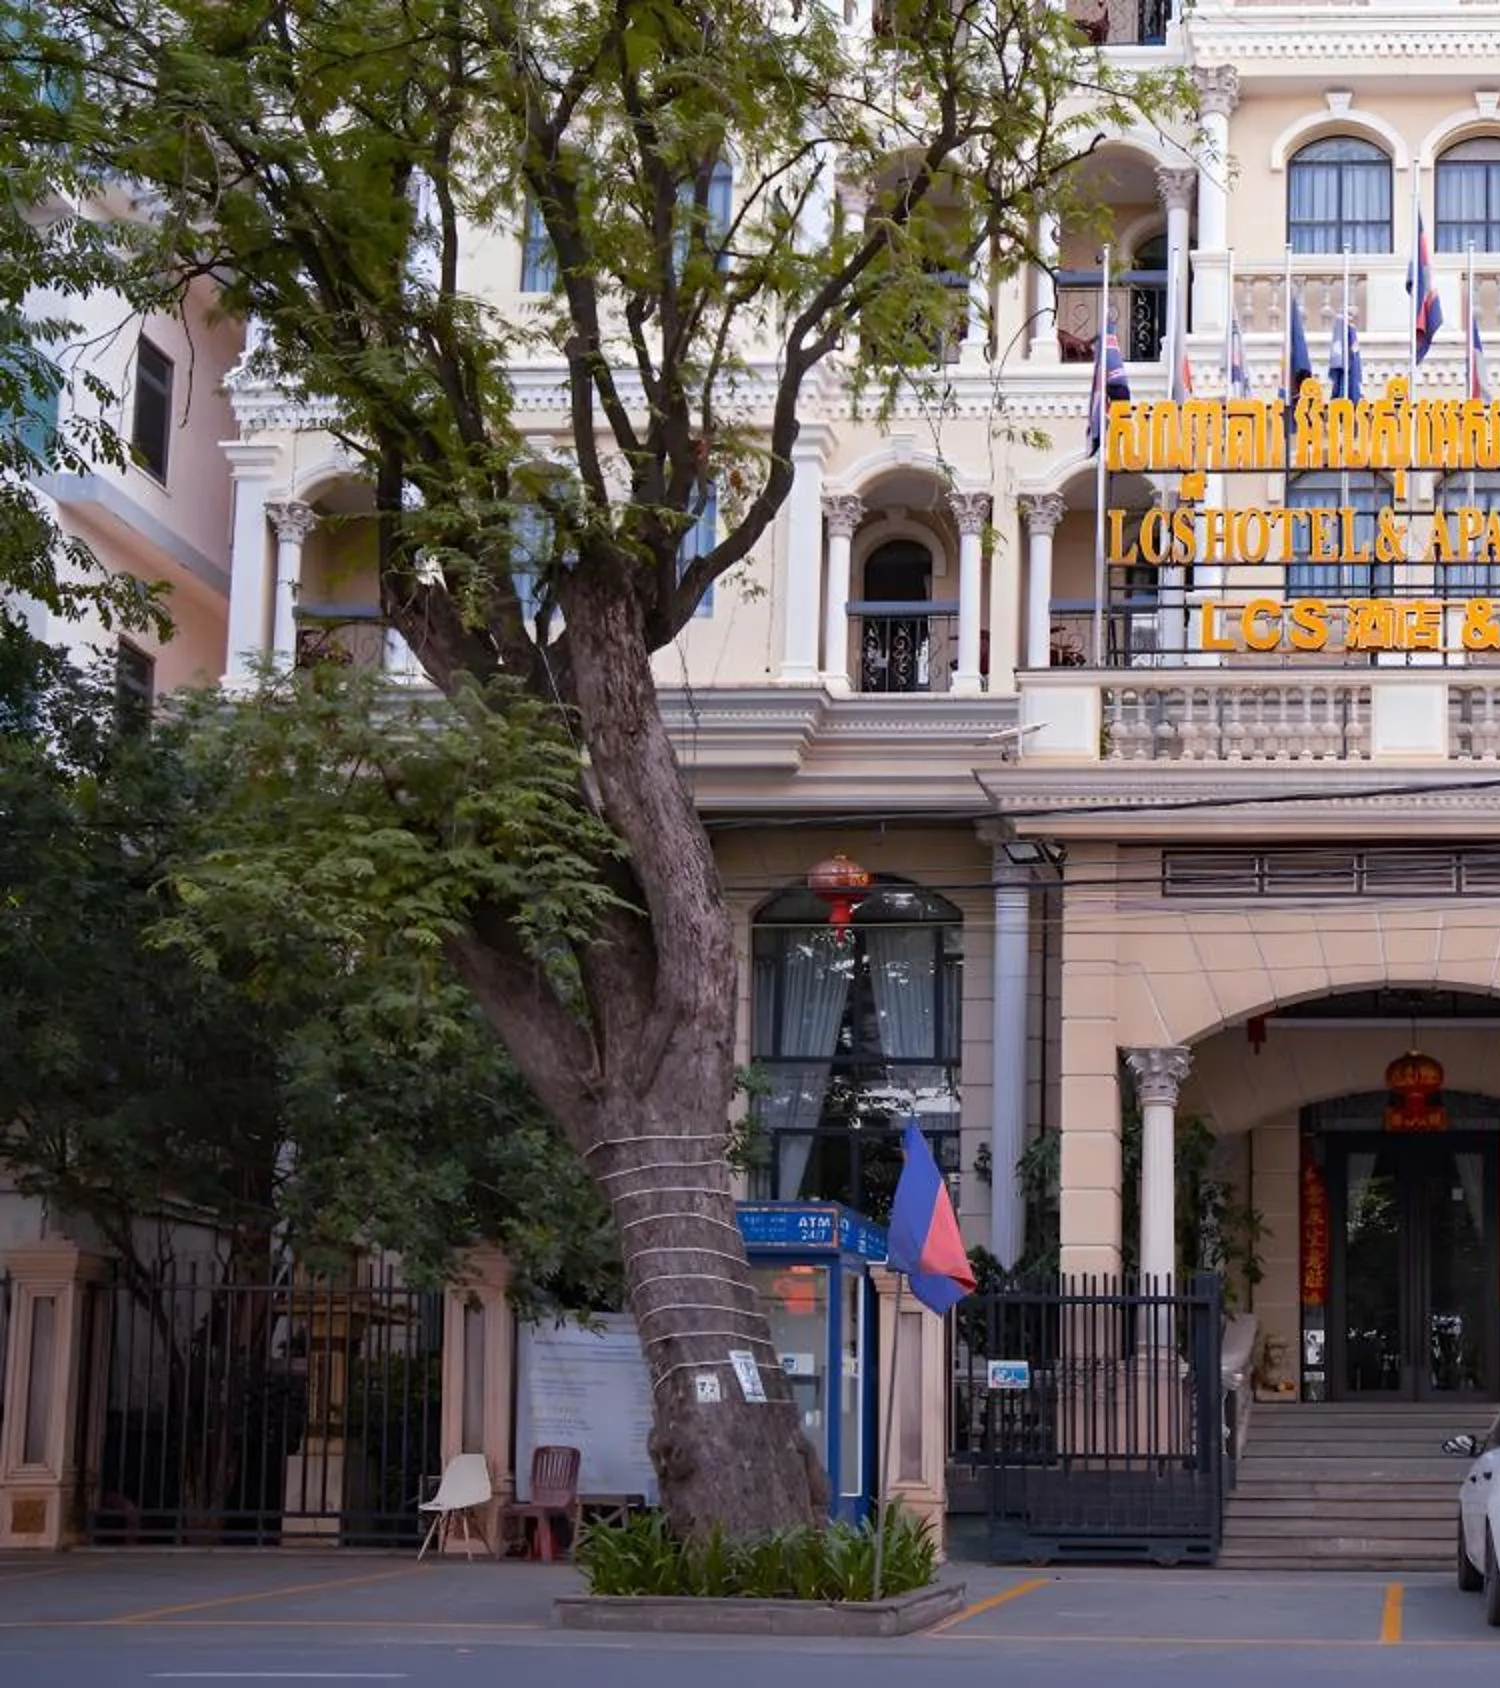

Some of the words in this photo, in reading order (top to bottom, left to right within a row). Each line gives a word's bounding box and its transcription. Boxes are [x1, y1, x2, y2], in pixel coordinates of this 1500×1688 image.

[1107, 505, 1197, 564] LCS
[1202, 507, 1373, 564] HOTEL
[1374, 505, 1408, 564] &
[1200, 597, 1329, 651] LCS
[1344, 599, 1443, 651] 酒店
[798, 1216, 831, 1228] ATM
